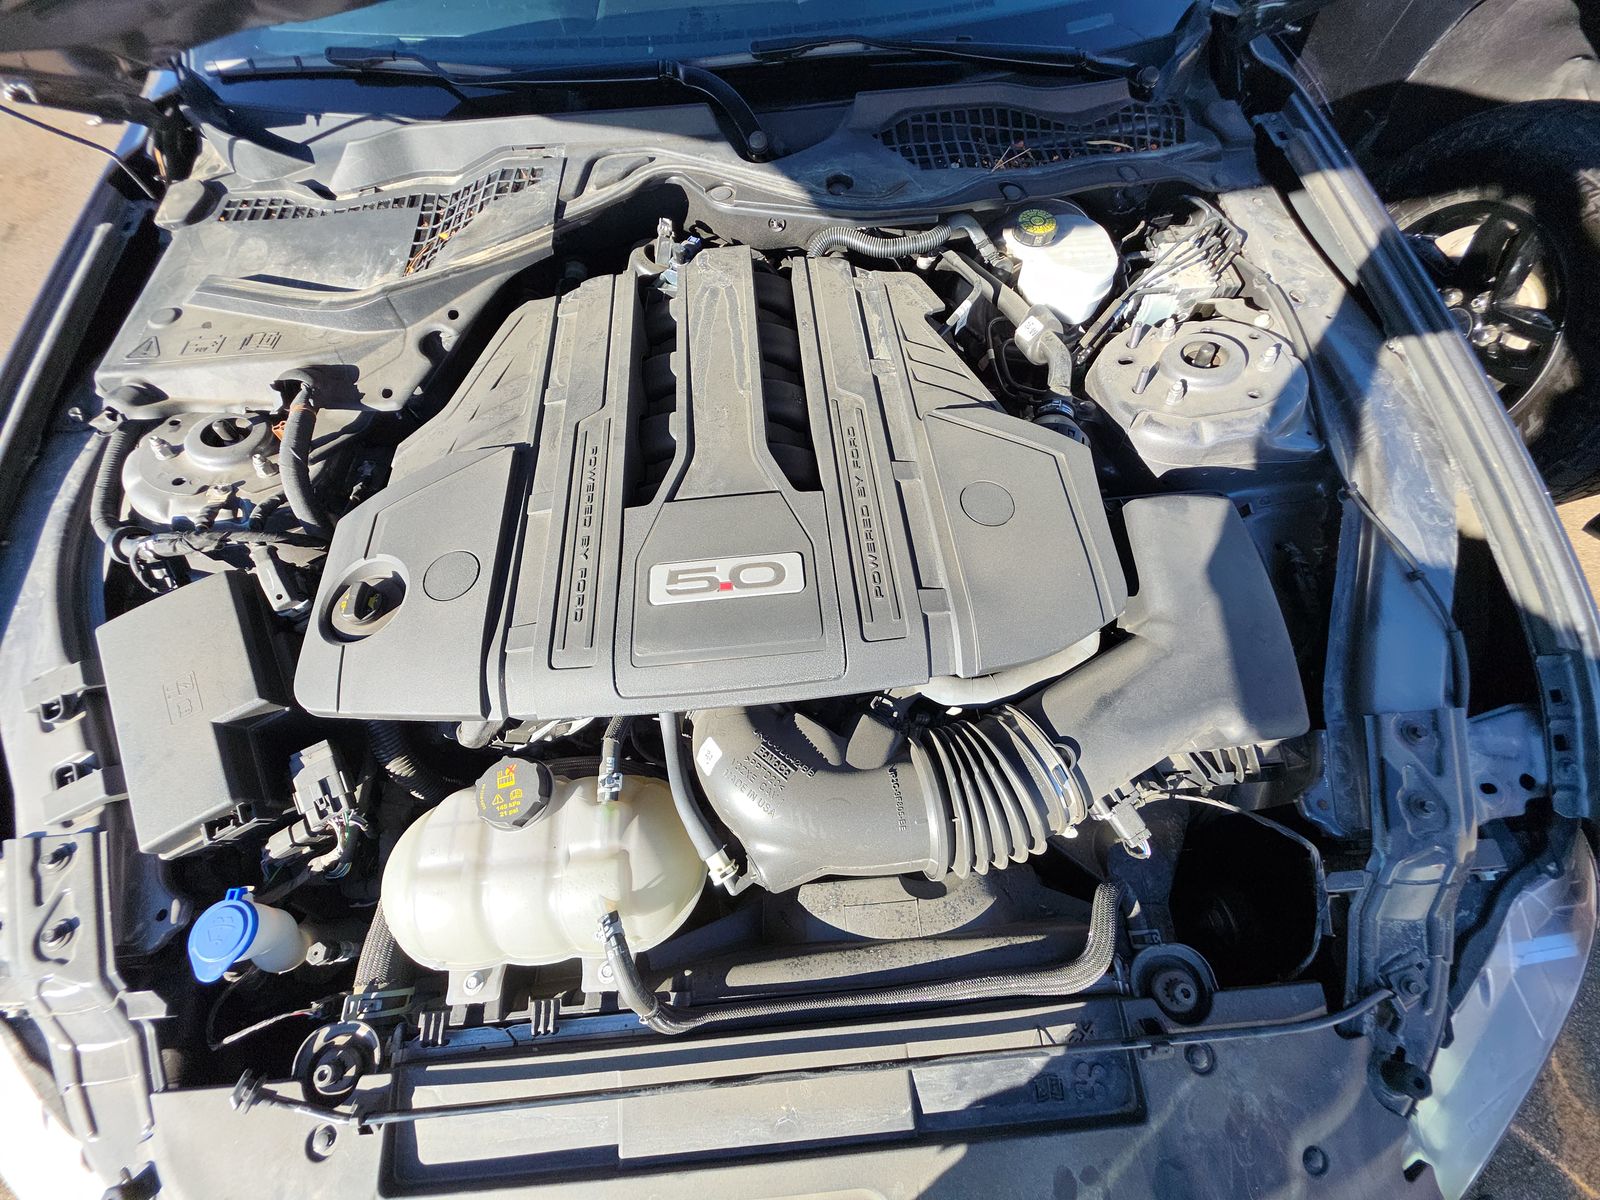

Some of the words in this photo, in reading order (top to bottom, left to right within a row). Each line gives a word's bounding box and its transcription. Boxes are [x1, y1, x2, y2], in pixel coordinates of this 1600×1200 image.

[847, 426, 861, 469] FORD
[582, 446, 598, 528] POWERED
[854, 475, 866, 498] BY
[580, 535, 591, 560] BY
[860, 504, 884, 599] POWERED
[573, 567, 587, 623] FORD
[665, 561, 786, 596] 5.0
